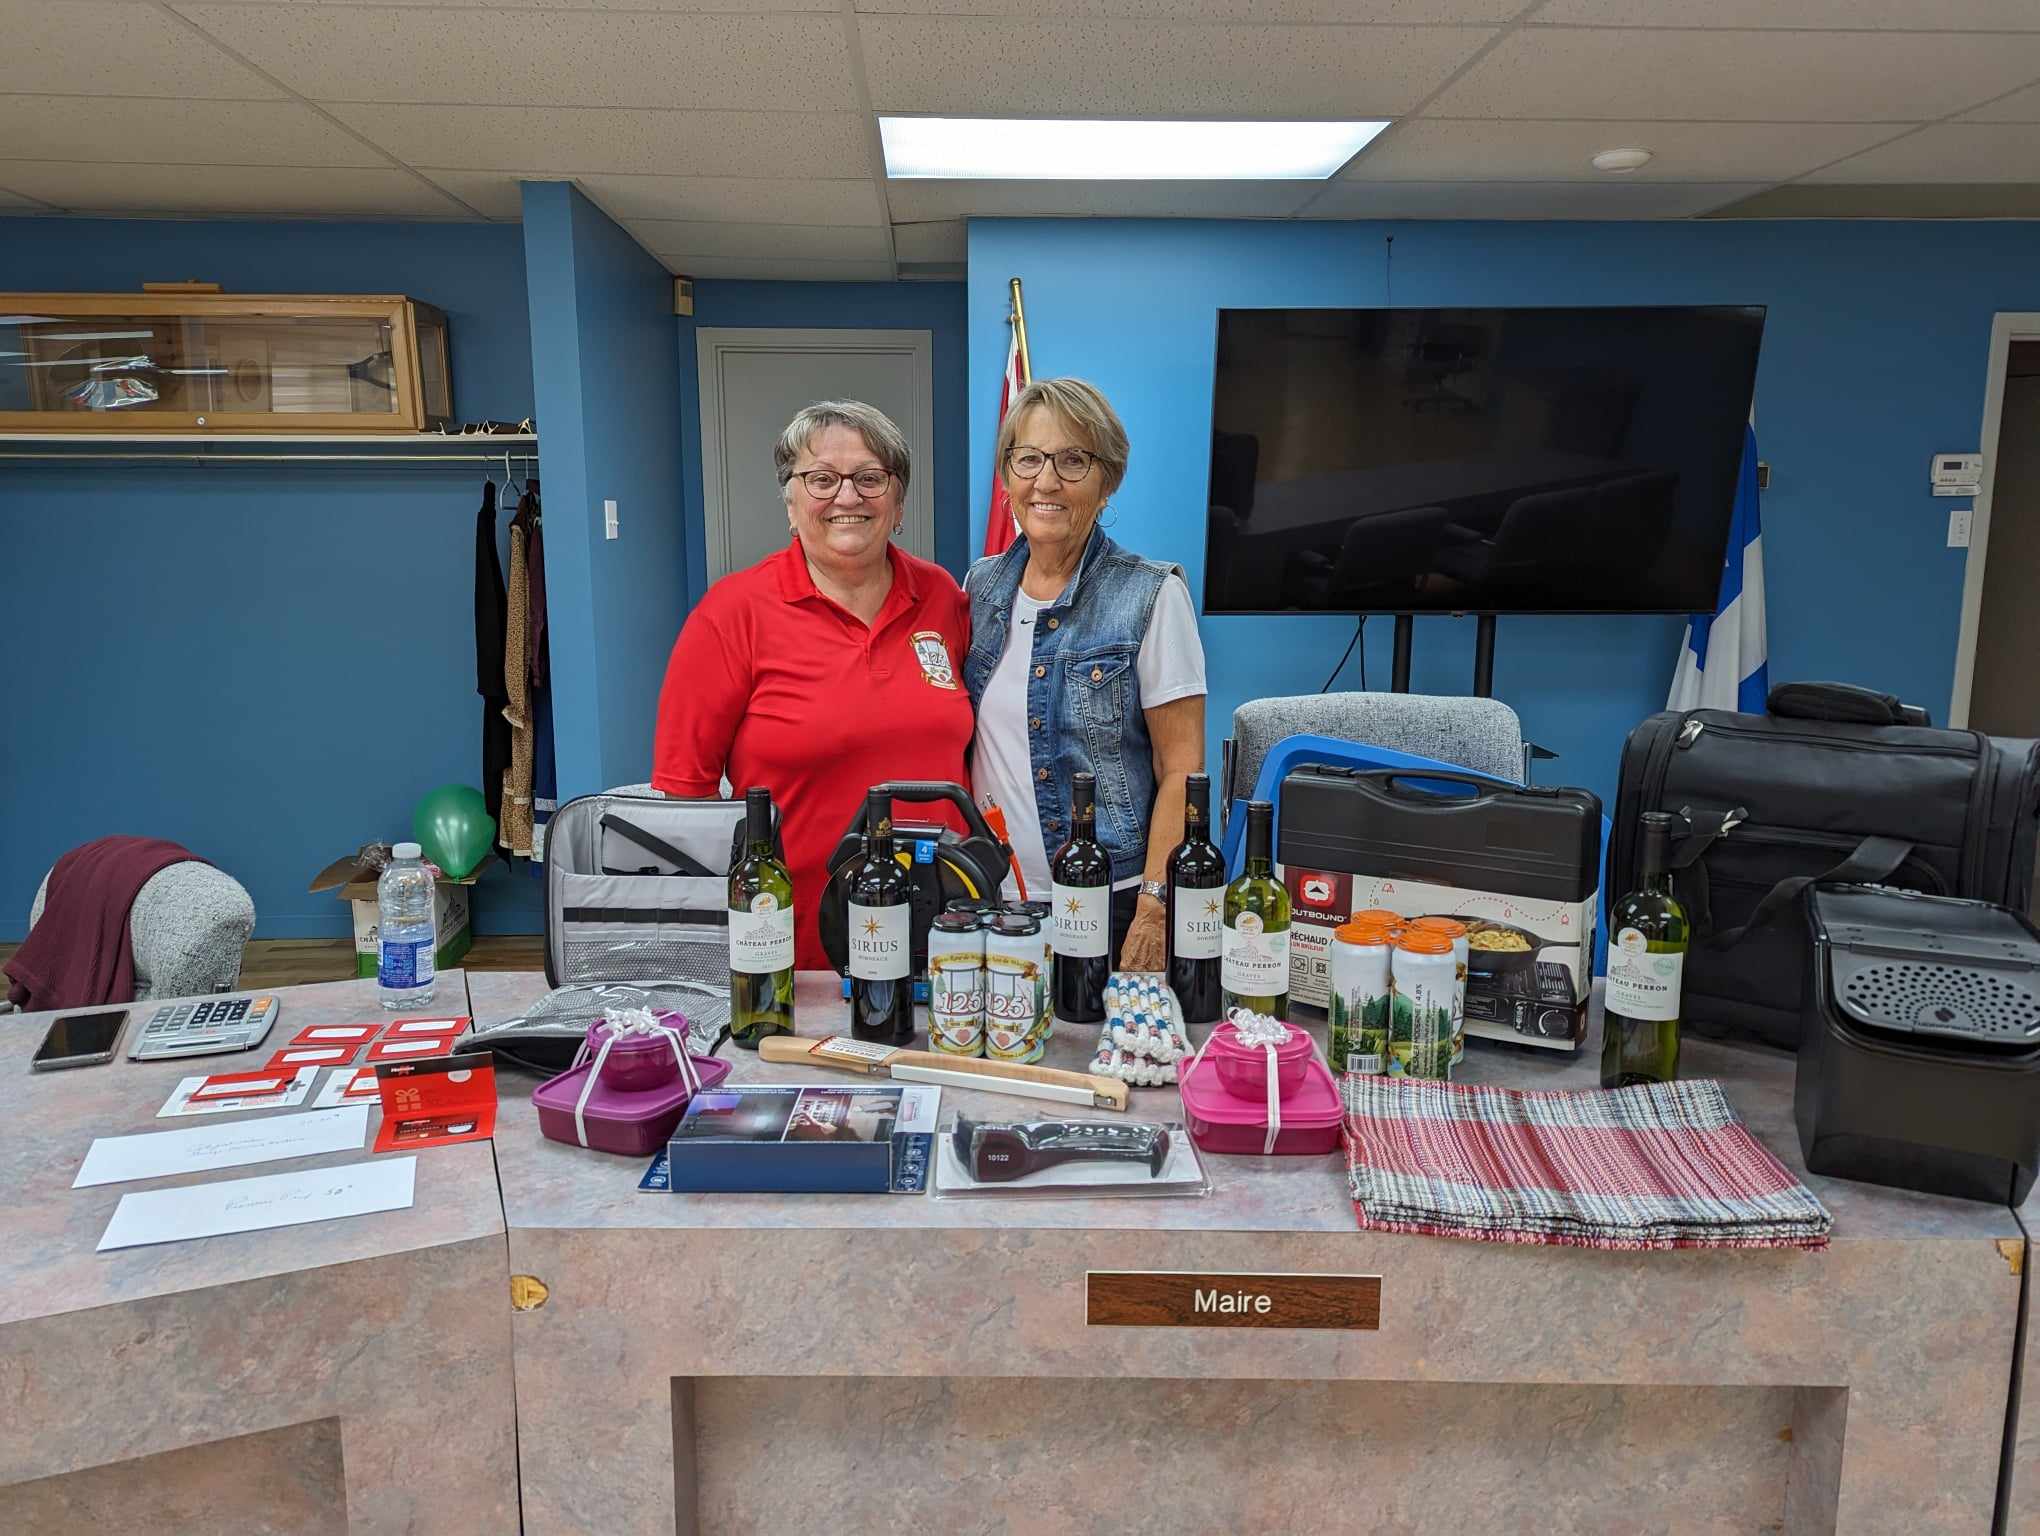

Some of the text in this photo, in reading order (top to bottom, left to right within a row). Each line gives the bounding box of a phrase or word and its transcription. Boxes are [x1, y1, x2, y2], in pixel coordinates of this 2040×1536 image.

[1291, 908, 1345, 922] OUTBOUND
[1055, 916, 1098, 931] SIRIUS
[1187, 920, 1223, 932] SIRI
[736, 938, 767, 947] CHÂTEAU
[1291, 931, 1328, 945] RÉCHAUD
[851, 938, 898, 953] SIRIUS
[1632, 983, 1668, 992] PERRON
[943, 991, 982, 1013] 125
[987, 1154, 1009, 1162] 10122
[1194, 1288, 1272, 1313] Maire
